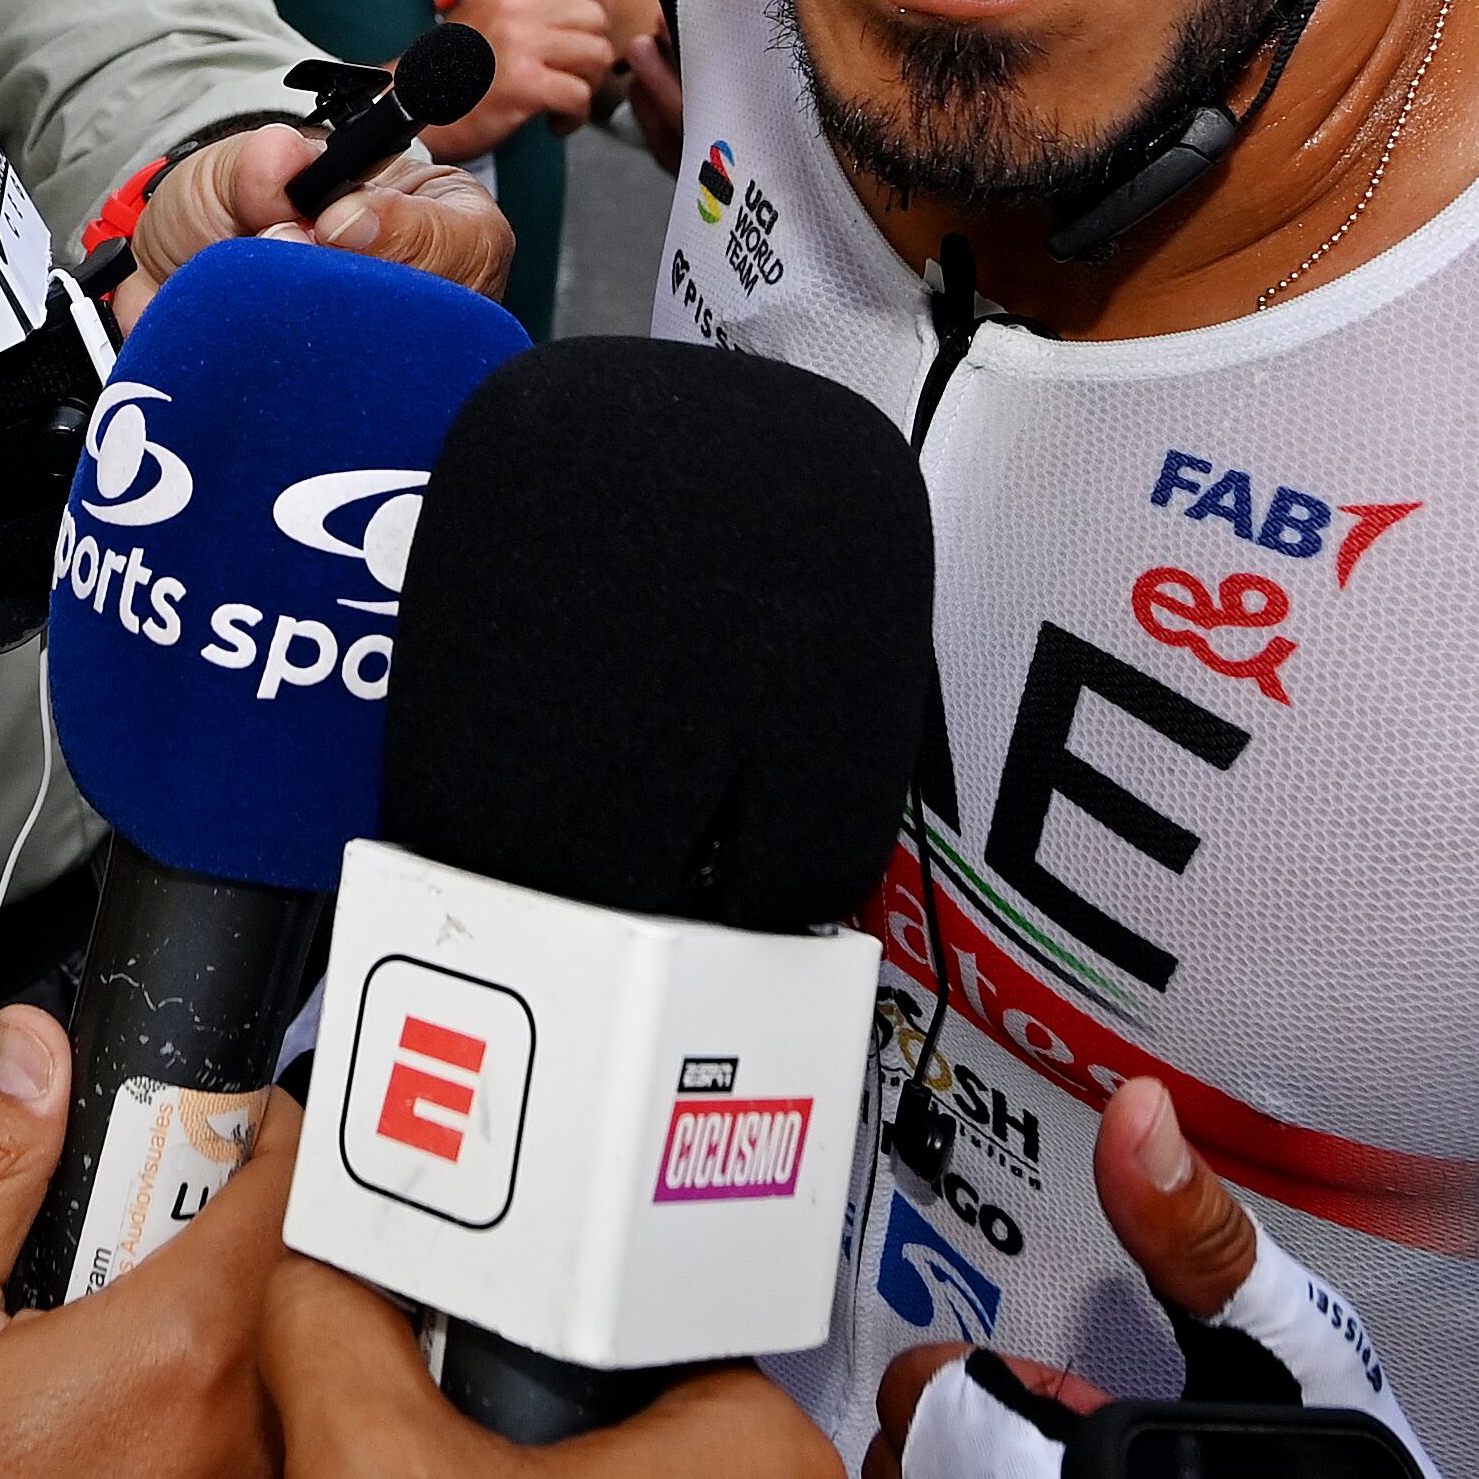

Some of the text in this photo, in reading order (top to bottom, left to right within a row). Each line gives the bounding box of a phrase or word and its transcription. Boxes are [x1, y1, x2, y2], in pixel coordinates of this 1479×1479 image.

[734, 204, 785, 286] WORLD
[744, 178, 779, 236] UCI
[724, 229, 760, 298] TEAM
[683, 278, 745, 352] PISS
[1149, 448, 1333, 559] FAB
[51, 501, 395, 702] ports spo
[121, 1101, 174, 1259] Audiovisuales
[664, 1111, 804, 1190] CICLISMO
